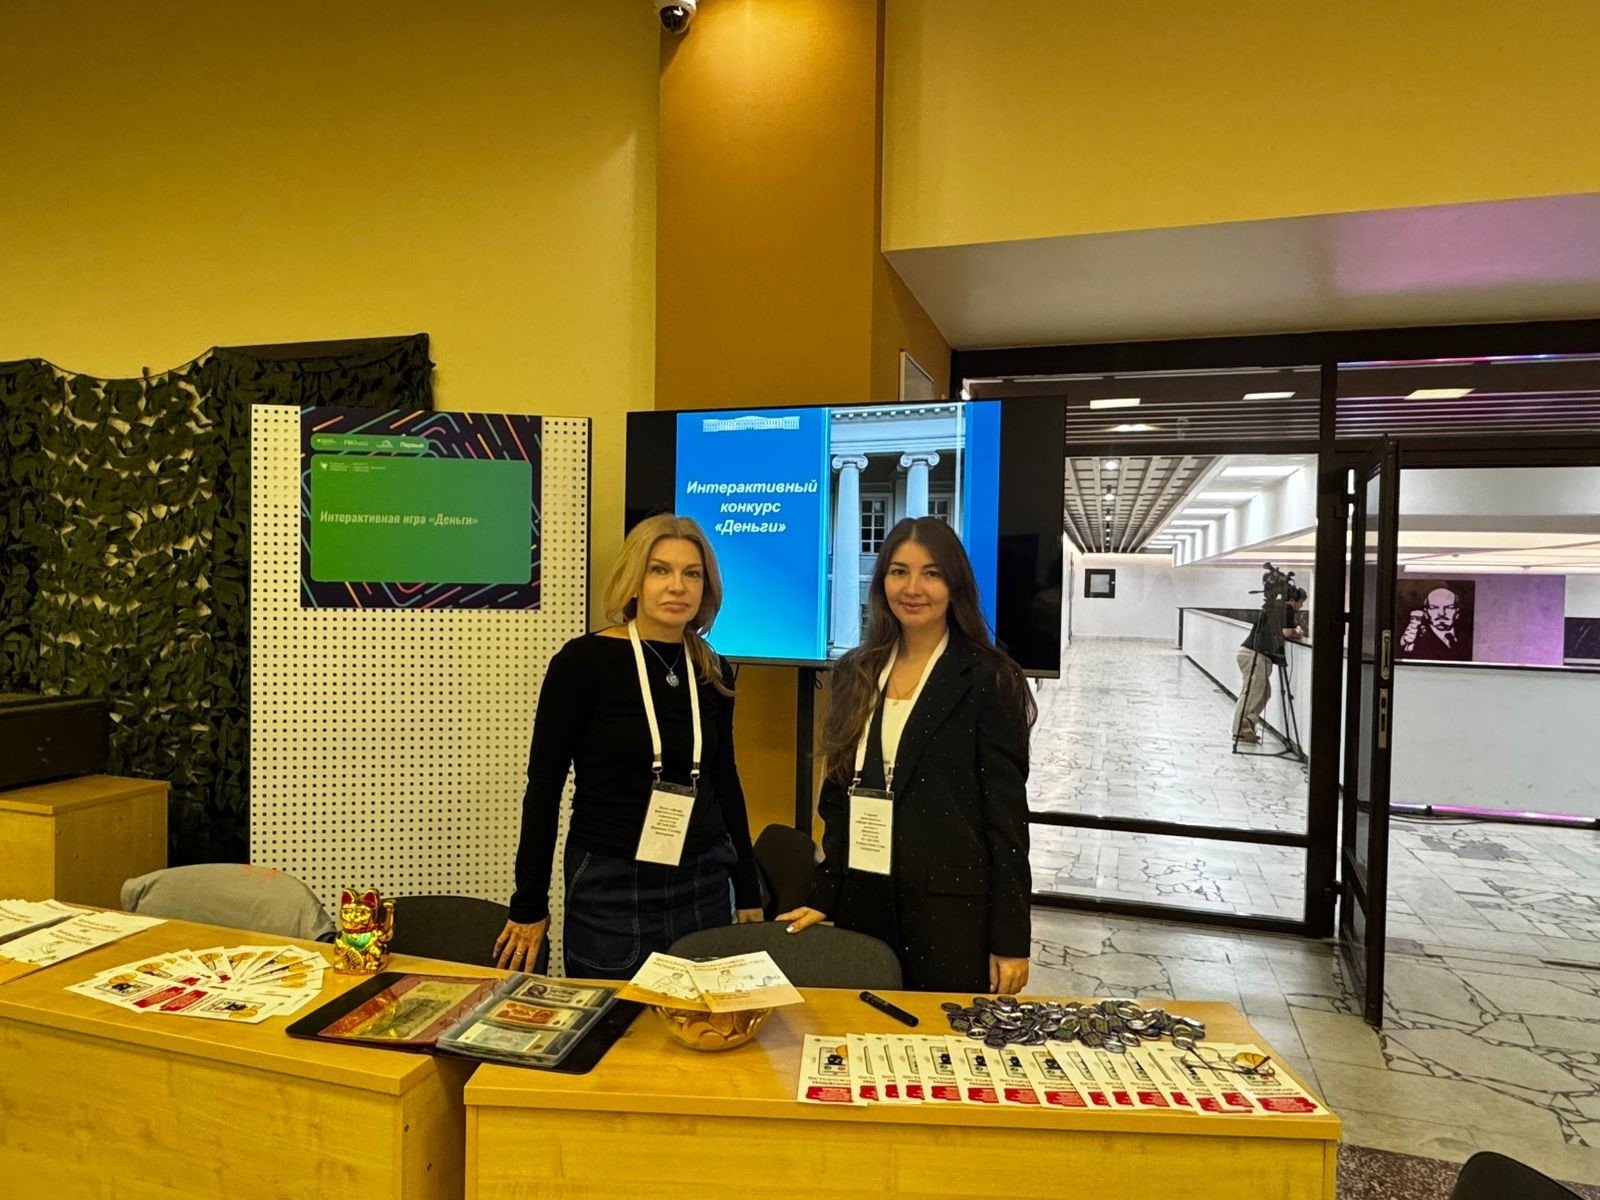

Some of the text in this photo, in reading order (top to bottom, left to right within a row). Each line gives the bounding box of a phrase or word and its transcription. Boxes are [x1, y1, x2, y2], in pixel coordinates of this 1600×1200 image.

[686, 479, 818, 496] Интерактивный
[720, 502, 781, 515] конкурс
[319, 510, 479, 526] Интерактивная игра «Деньги»
[715, 519, 786, 535] «Деньги»
